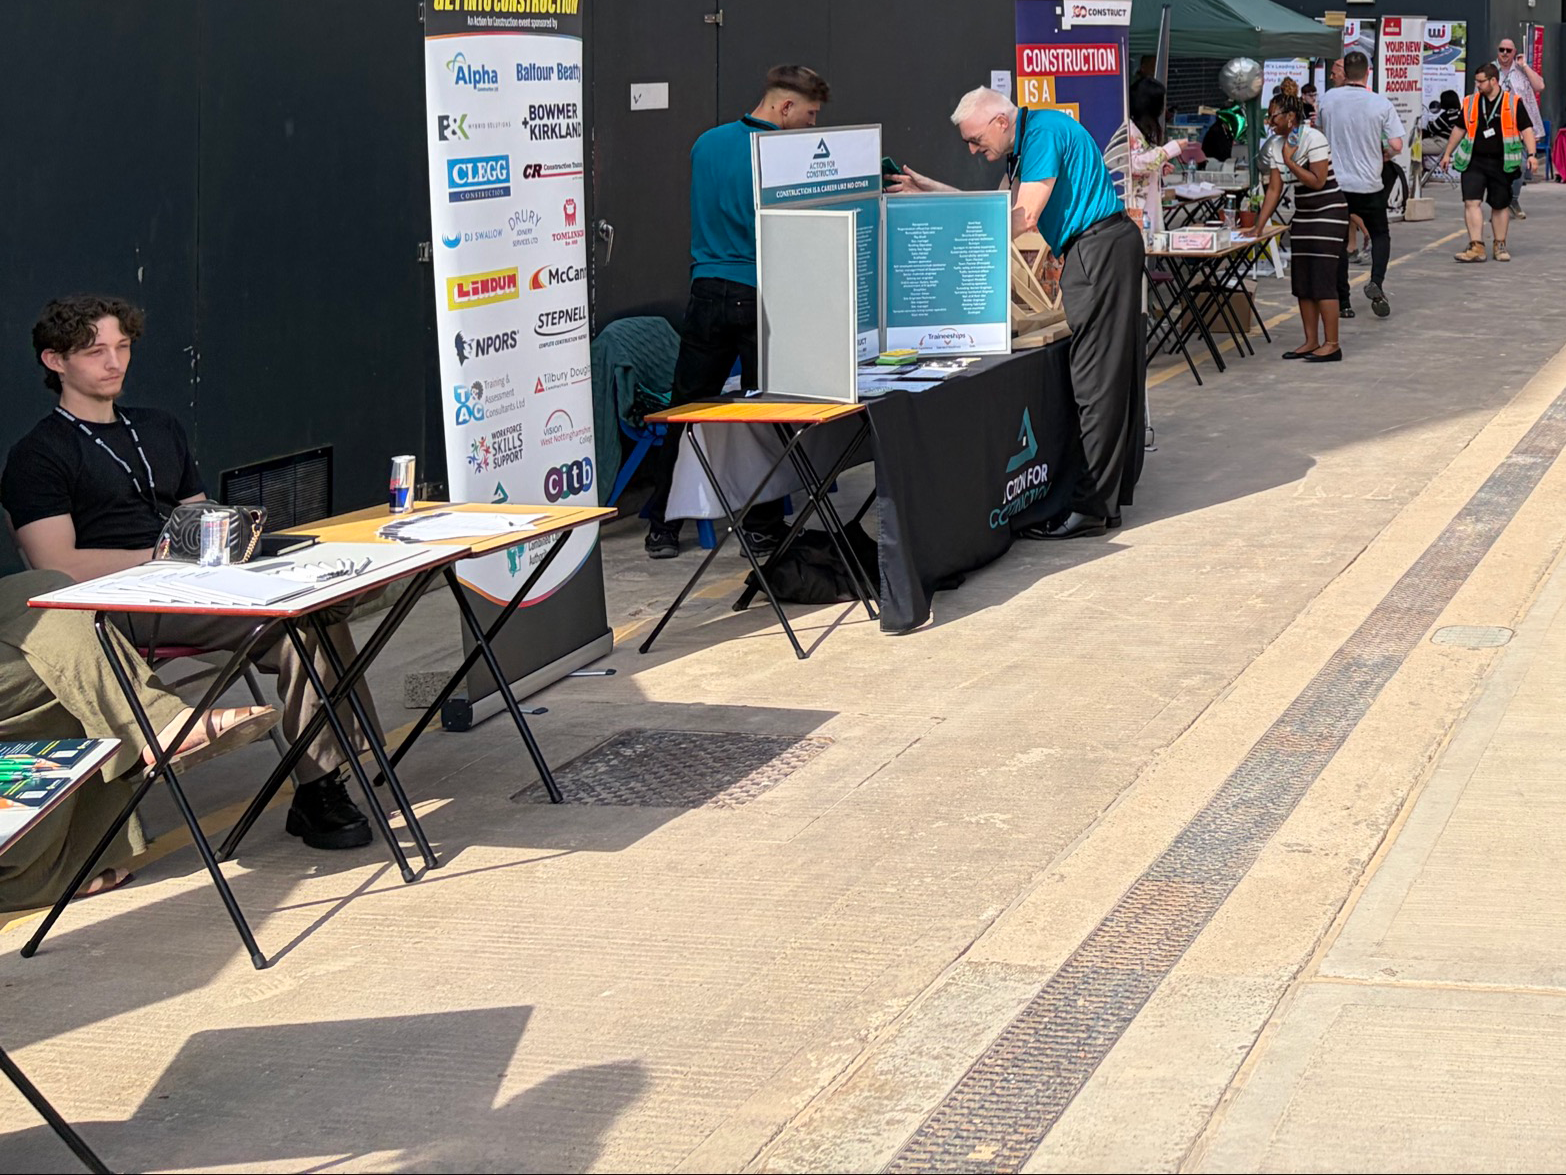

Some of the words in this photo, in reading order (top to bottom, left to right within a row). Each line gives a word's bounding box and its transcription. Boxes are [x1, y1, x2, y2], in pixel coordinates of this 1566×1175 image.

[1088, 8, 1127, 17] CONSTRUCT
[1384, 41, 1404, 53] YOUR
[1405, 41, 1421, 53] NEW
[1023, 48, 1116, 72] CONSTRUCTION
[1384, 54, 1420, 66] HOWDENS
[455, 64, 498, 90] Alpha
[516, 62, 554, 82] Balfour
[1385, 67, 1408, 79] TRADE
[1024, 79, 1039, 104] IS
[1041, 79, 1051, 103] A
[528, 103, 578, 121] BOWMER
[487, 121, 512, 129] SOLUTIONS
[530, 122, 582, 141] KIRKLAND
[452, 160, 507, 184] CLEGG
[523, 163, 542, 180] CR
[806, 168, 839, 179] CONSTRUCTION
[809, 161, 826, 170] ACTION
[827, 160, 836, 168] FOR
[460, 189, 504, 200] CONSTRUCTION
[776, 187, 813, 198] CONSTRUCTION
[821, 183, 838, 193] CAREER
[508, 209, 542, 232] DRURY
[464, 232, 473, 242] DJ
[475, 229, 503, 241] SWALLOW
[512, 239, 530, 248] SERVICES
[537, 305, 586, 329] STEPNELL
[475, 330, 517, 357] NPORS
[484, 377, 506, 390] Training
[544, 372, 569, 383] Tilbury
[485, 388, 515, 405] Assessment
[485, 402, 516, 419] Consultants
[516, 398, 526, 409] Ltd
[491, 423, 523, 440] WORKFORCE
[492, 433, 523, 457] SKILLS
[540, 435, 553, 447] West
[493, 449, 523, 469] SUPPORT
[548, 460, 592, 495] citb
[1027, 463, 1048, 487] FOR
